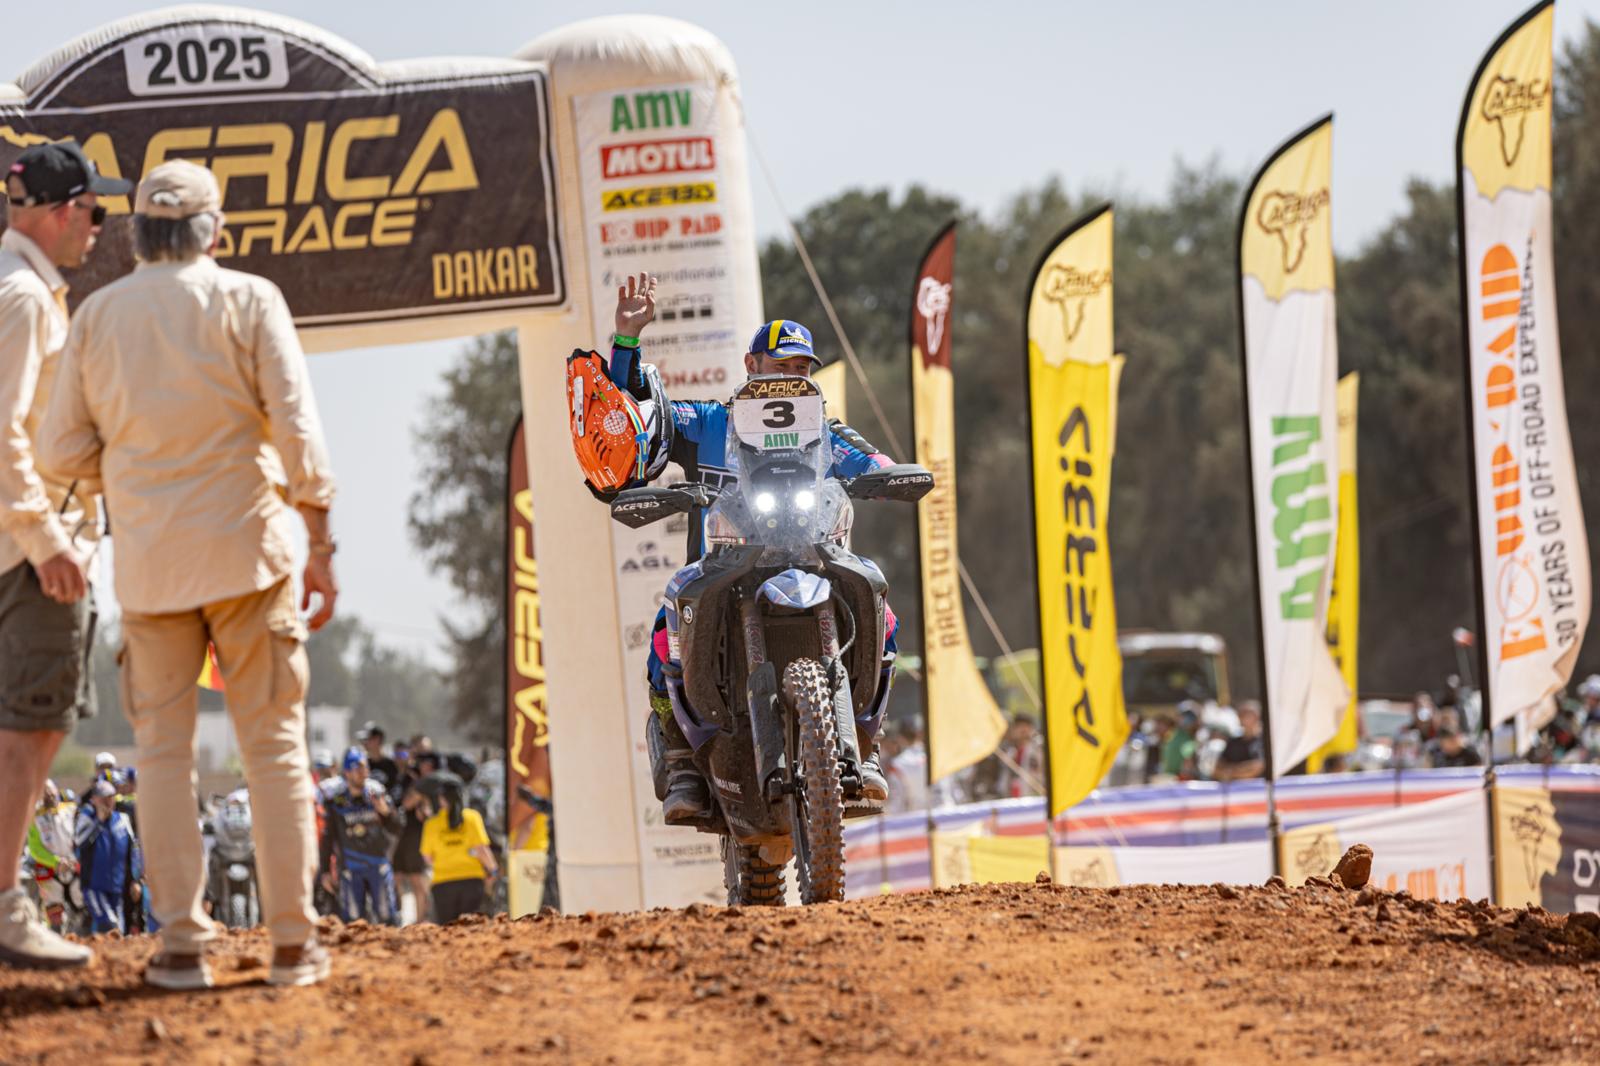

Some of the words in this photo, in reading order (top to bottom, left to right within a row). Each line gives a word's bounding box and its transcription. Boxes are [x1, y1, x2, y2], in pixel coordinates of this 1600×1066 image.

[144, 37, 272, 86] 2025
[606, 140, 712, 176] MOTUL
[432, 245, 538, 298] DAKAR
[757, 381, 808, 396] AFRICA
[762, 400, 796, 429] 3
[1521, 384, 1554, 498] OFF-ROAD
[887, 475, 932, 486] ACERBIS
[614, 501, 660, 512] ACERBIS
[1534, 508, 1562, 535] OF
[1541, 541, 1576, 614] YEARS
[1557, 618, 1578, 648] 30
